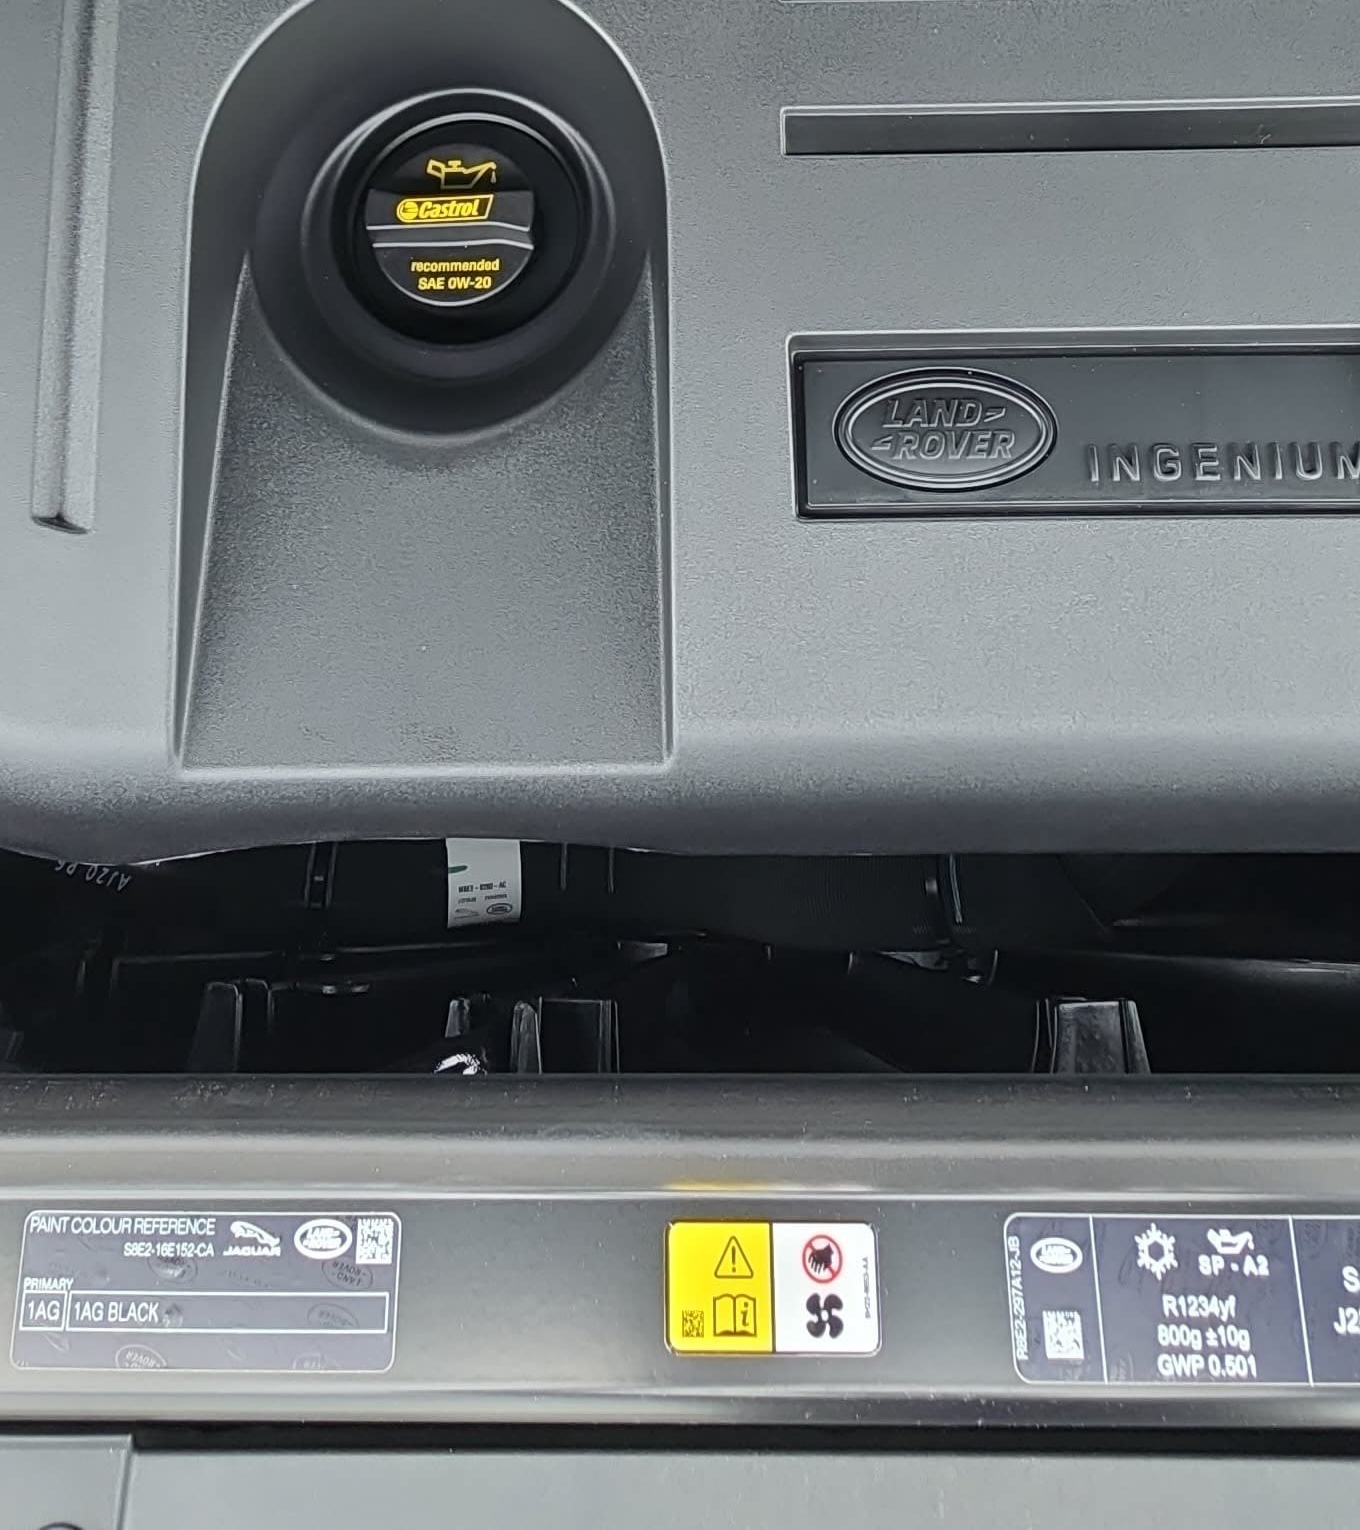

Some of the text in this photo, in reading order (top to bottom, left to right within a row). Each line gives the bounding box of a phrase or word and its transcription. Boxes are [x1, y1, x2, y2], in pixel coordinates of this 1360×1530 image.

[418, 199, 480, 219] Castrol
[410, 258, 500, 272] recommended
[418, 275, 493, 291] SAE 0W-20
[882, 397, 983, 428] LAND
[890, 427, 1019, 462] ROVER
[29, 1216, 216, 1236] PAINT COLOUR REFERENCE
[123, 1241, 215, 1258] S8E2-16E152-CA
[223, 1245, 281, 1258] JAGUAR
[1198, 1254, 1225, 1276] SP
[1243, 1255, 1270, 1277] A2
[23, 1277, 74, 1291] PRIMARY
[27, 1300, 61, 1321] 1AG
[74, 1301, 160, 1324] 1AG BLACK
[1162, 1294, 1238, 1323] R1234yf
[1157, 1325, 1252, 1351] 800g ±10g
[1157, 1354, 1258, 1379] GWP 0.501
